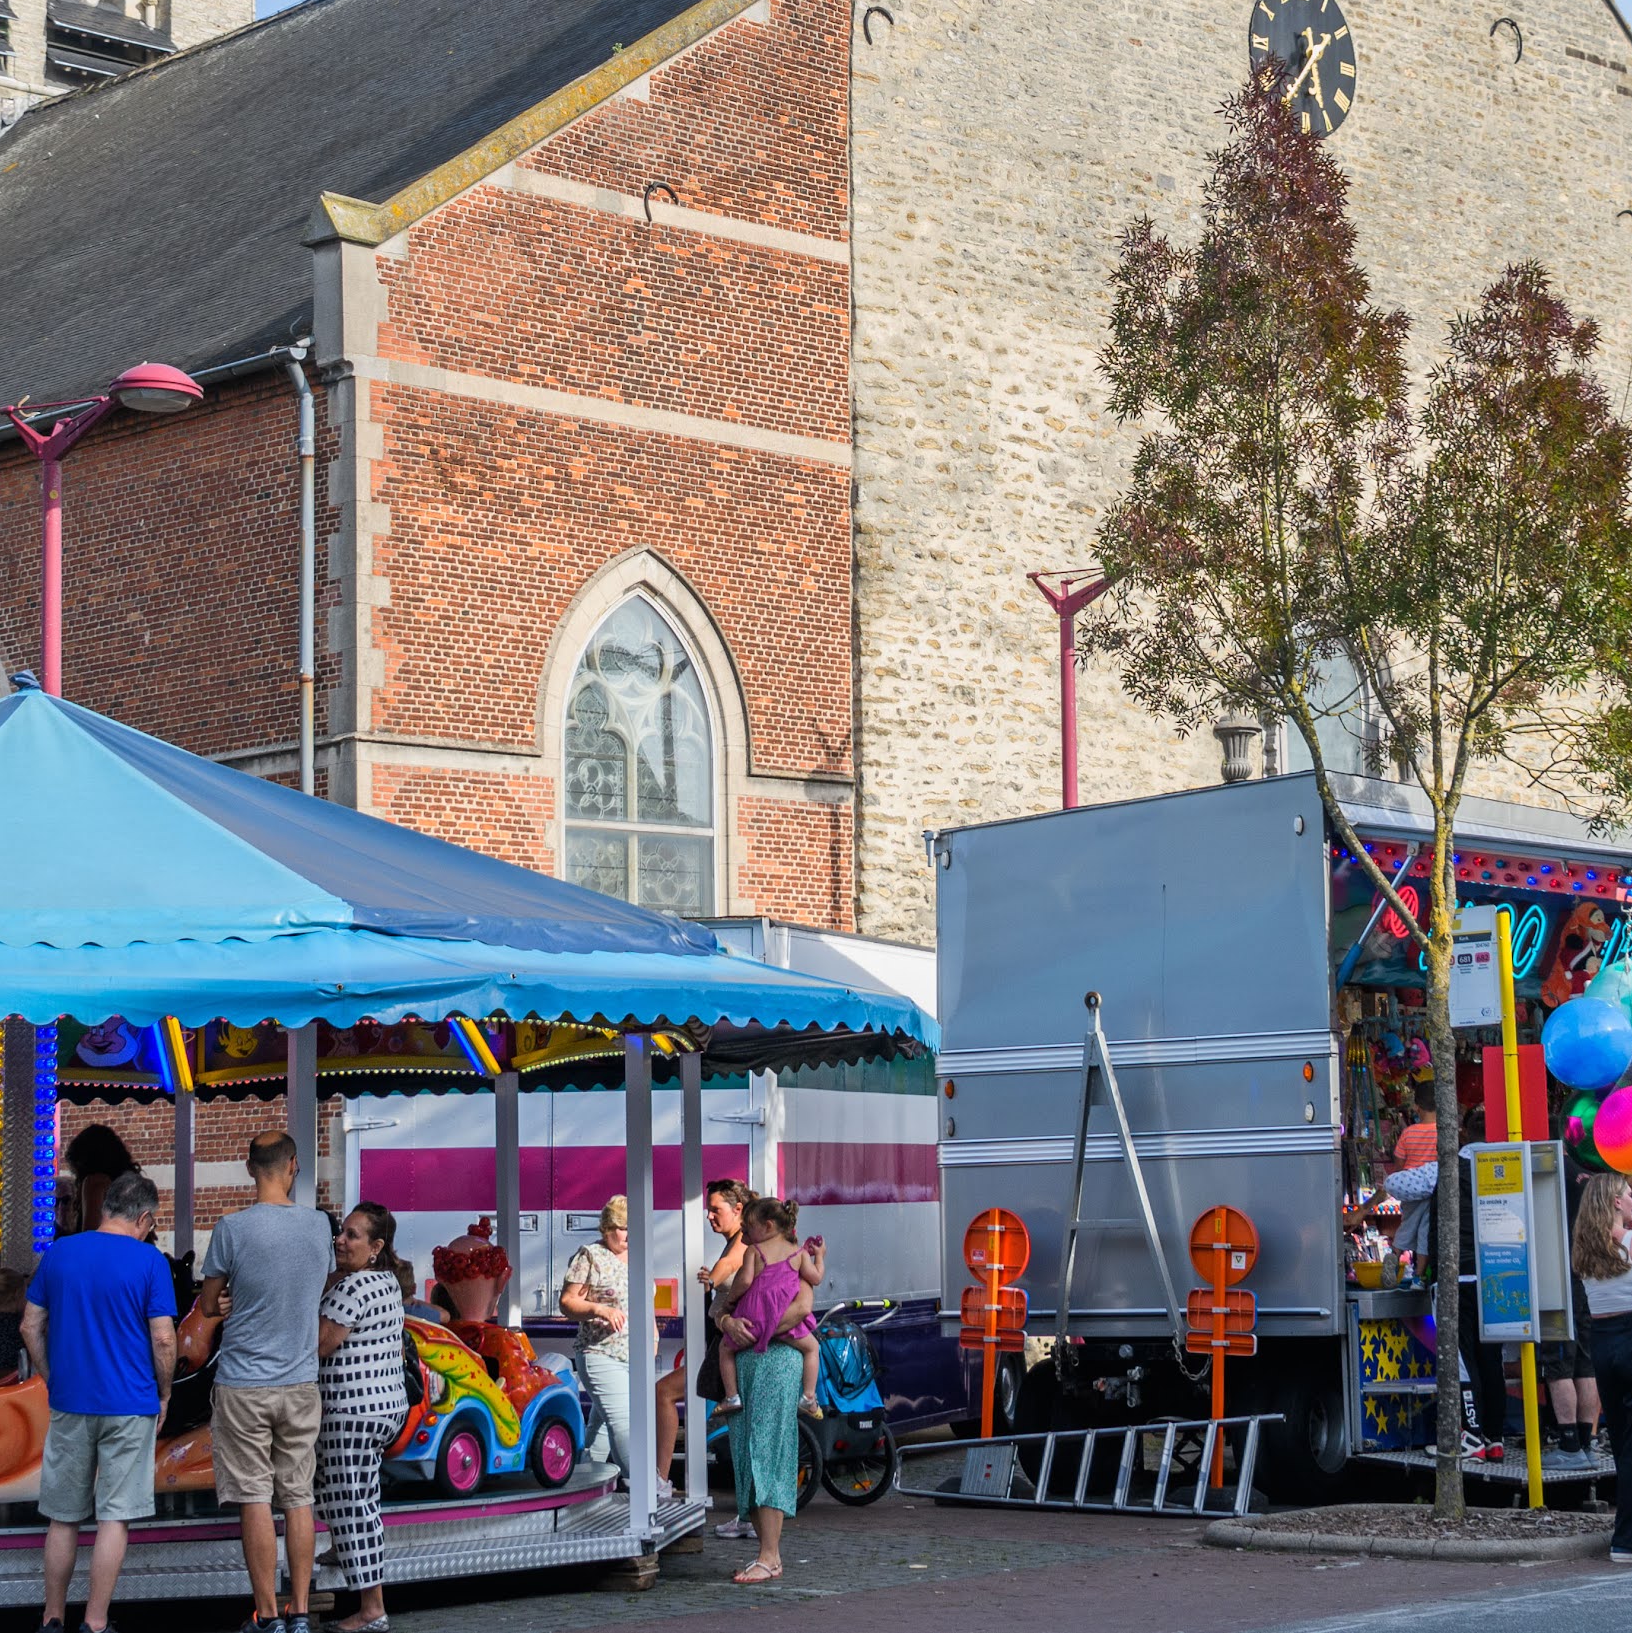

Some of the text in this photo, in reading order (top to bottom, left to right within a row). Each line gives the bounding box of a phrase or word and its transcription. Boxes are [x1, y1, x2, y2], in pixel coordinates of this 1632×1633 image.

[1258, 0, 1275, 21] X
[1334, 25, 1349, 40] II
[1252, 33, 1269, 51] IX
[1340, 61, 1355, 78] III
[1333, 88, 1351, 114] IIII
[1322, 109, 1333, 132] V
[1459, 956, 1471, 964] 681
